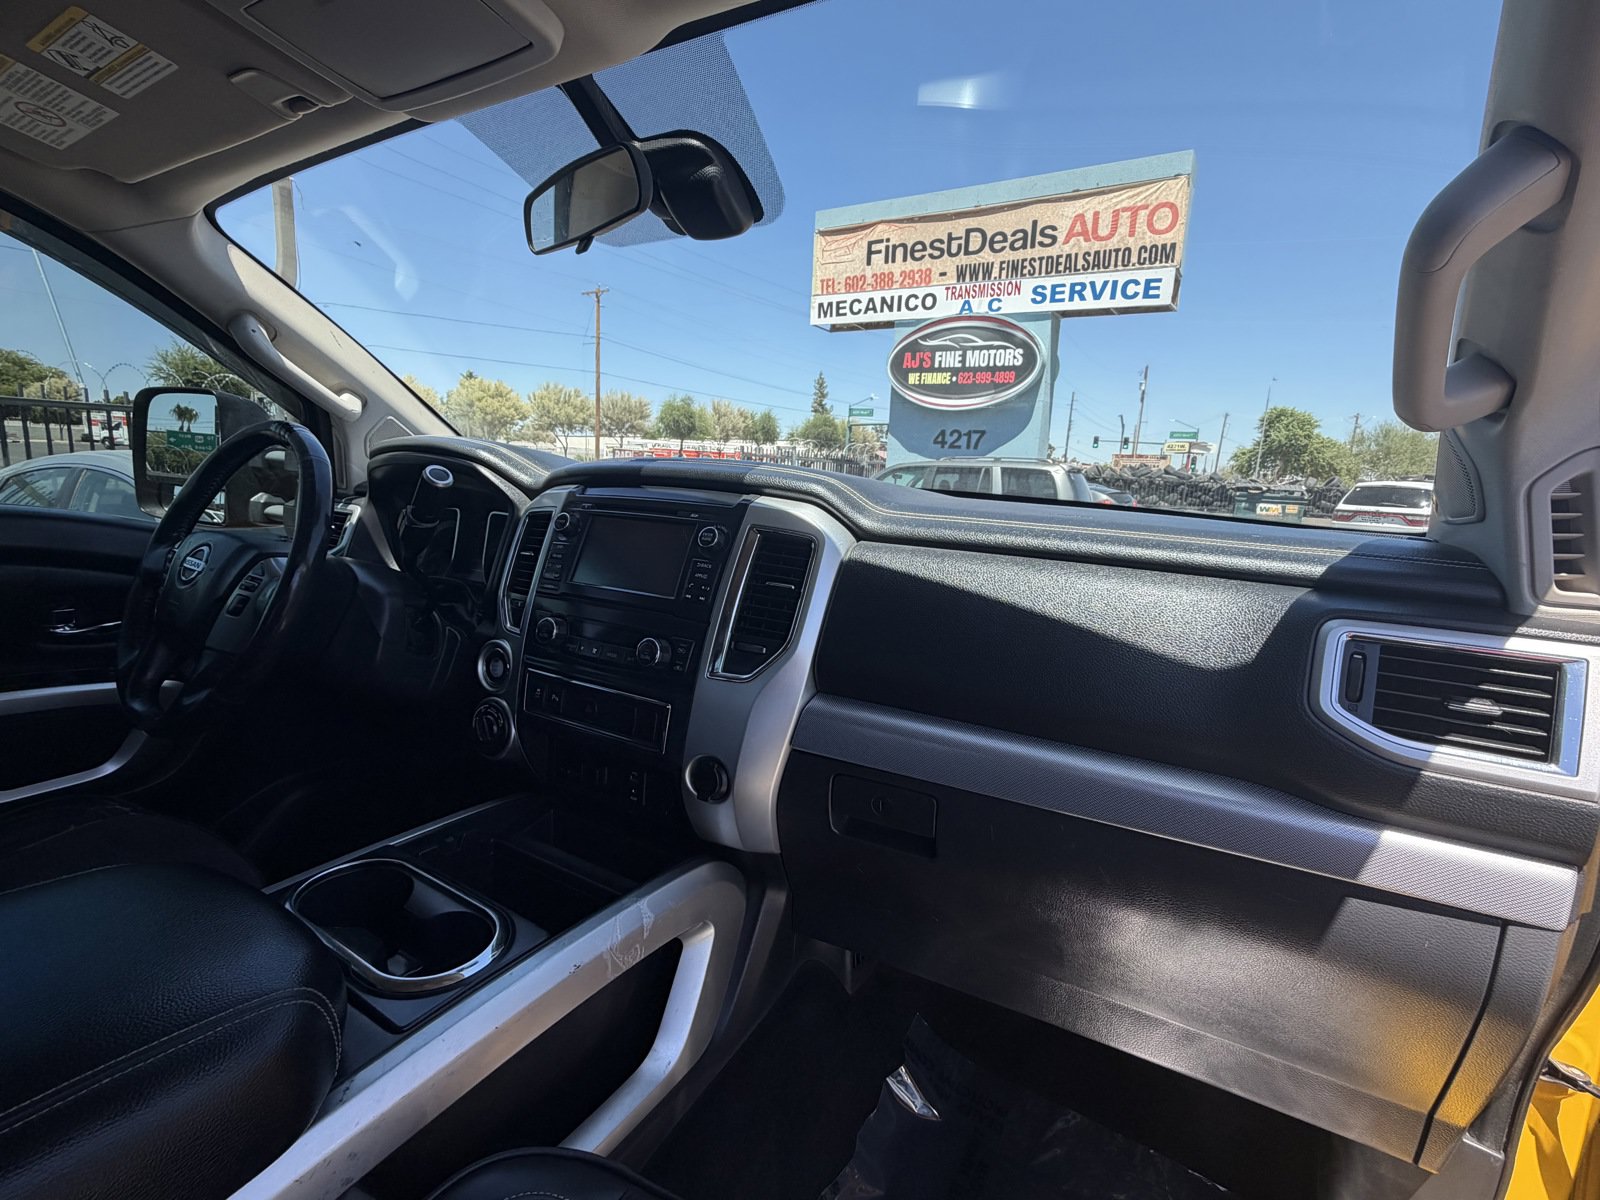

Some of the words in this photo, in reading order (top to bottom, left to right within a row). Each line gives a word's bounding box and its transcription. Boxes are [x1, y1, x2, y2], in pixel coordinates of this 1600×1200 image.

[865, 219, 1058, 266] FinestDeals
[1062, 201, 1180, 246] AUTO
[820, 277, 841, 295] TEL:
[844, 267, 933, 292] 602-388-2938
[955, 242, 1177, 283] WWW.FINESTDEALSAUTO.COM
[944, 280, 1022, 301] TRANSMISSION
[1030, 277, 1163, 305] SERVICE
[817, 292, 937, 319] MECANICO
[959, 299, 973, 315] A
[988, 297, 1003, 313] C
[903, 351, 932, 369] AJ'S
[934, 350, 962, 368] FINE
[965, 348, 1024, 368] MOTORS
[908, 373, 920, 385] WE
[920, 372, 952, 385] FINANCE
[932, 429, 987, 450] 4217
